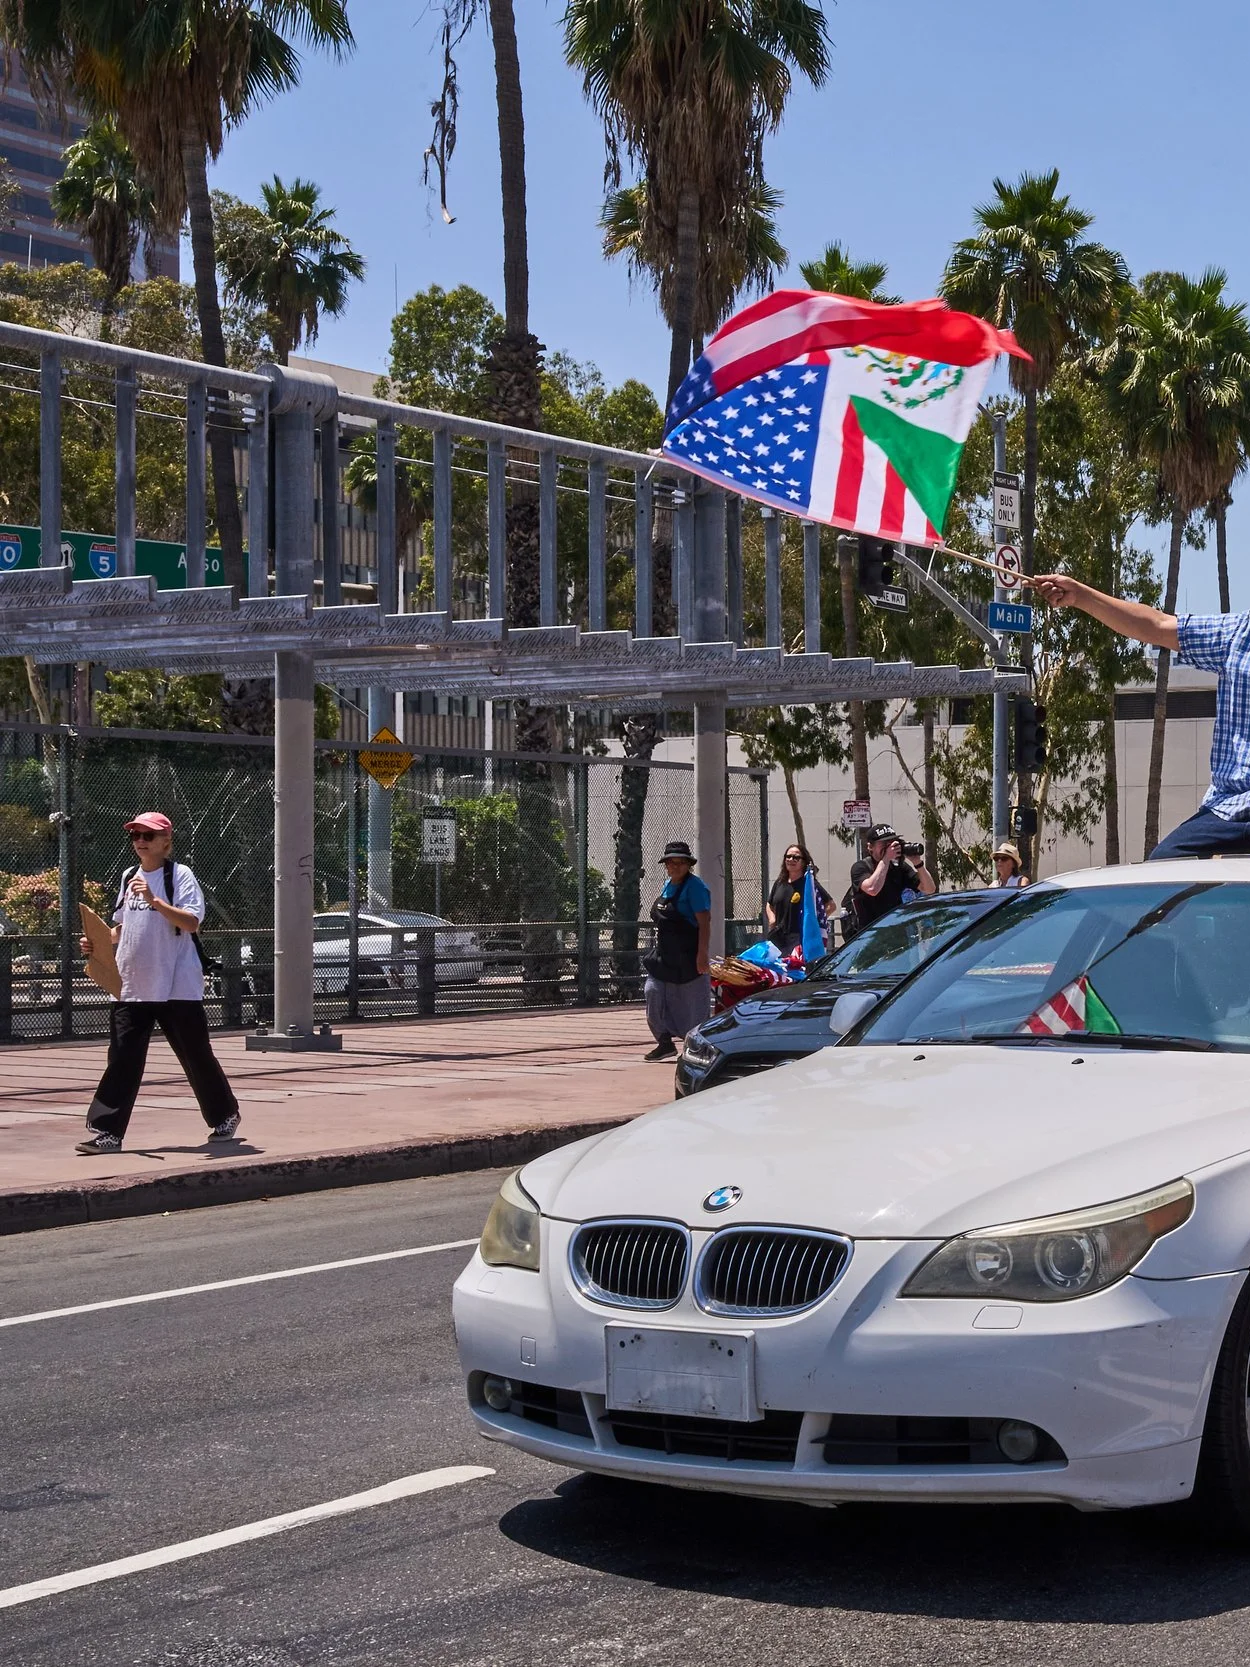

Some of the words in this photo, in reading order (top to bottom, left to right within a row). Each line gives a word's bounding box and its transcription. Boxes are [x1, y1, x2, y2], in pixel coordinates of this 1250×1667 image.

[996, 476, 1006, 485] RIGHT
[1007, 479, 1017, 487] LANE
[1000, 494, 1013, 507] BUS
[998, 509, 1015, 522] ONLY
[0, 546, 16, 563] 0
[99, 555, 111, 573] 5
[890, 594, 904, 605] WAY
[996, 607, 1025, 624] Main
[370, 760, 402, 769] MERGE
[431, 824, 448, 833] BUS
[430, 836, 450, 845] LANE
